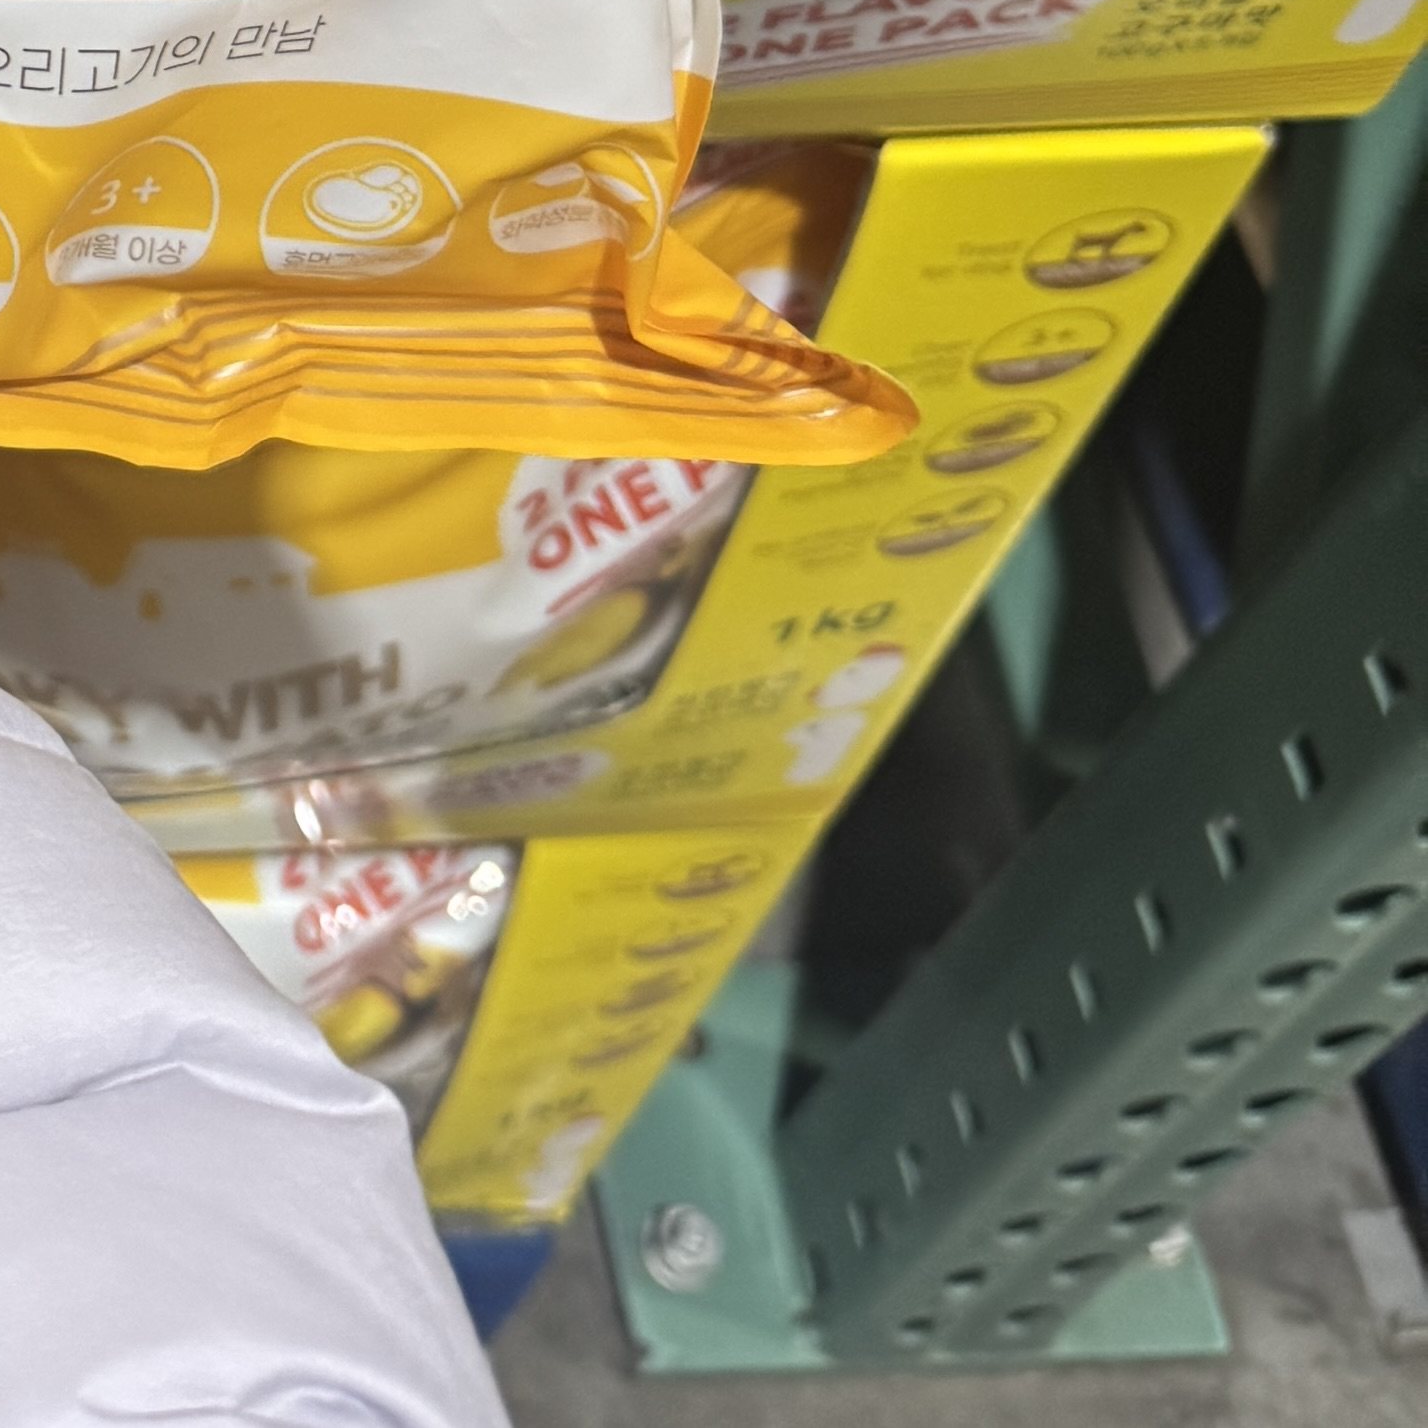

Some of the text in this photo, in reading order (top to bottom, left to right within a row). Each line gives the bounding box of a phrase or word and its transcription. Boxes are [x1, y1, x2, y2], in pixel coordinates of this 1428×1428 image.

[227, 12, 328, 63] 만남
[128, 236, 188, 266] 이상
[528, 460, 672, 572] ONE
[165, 640, 402, 742] WITH
